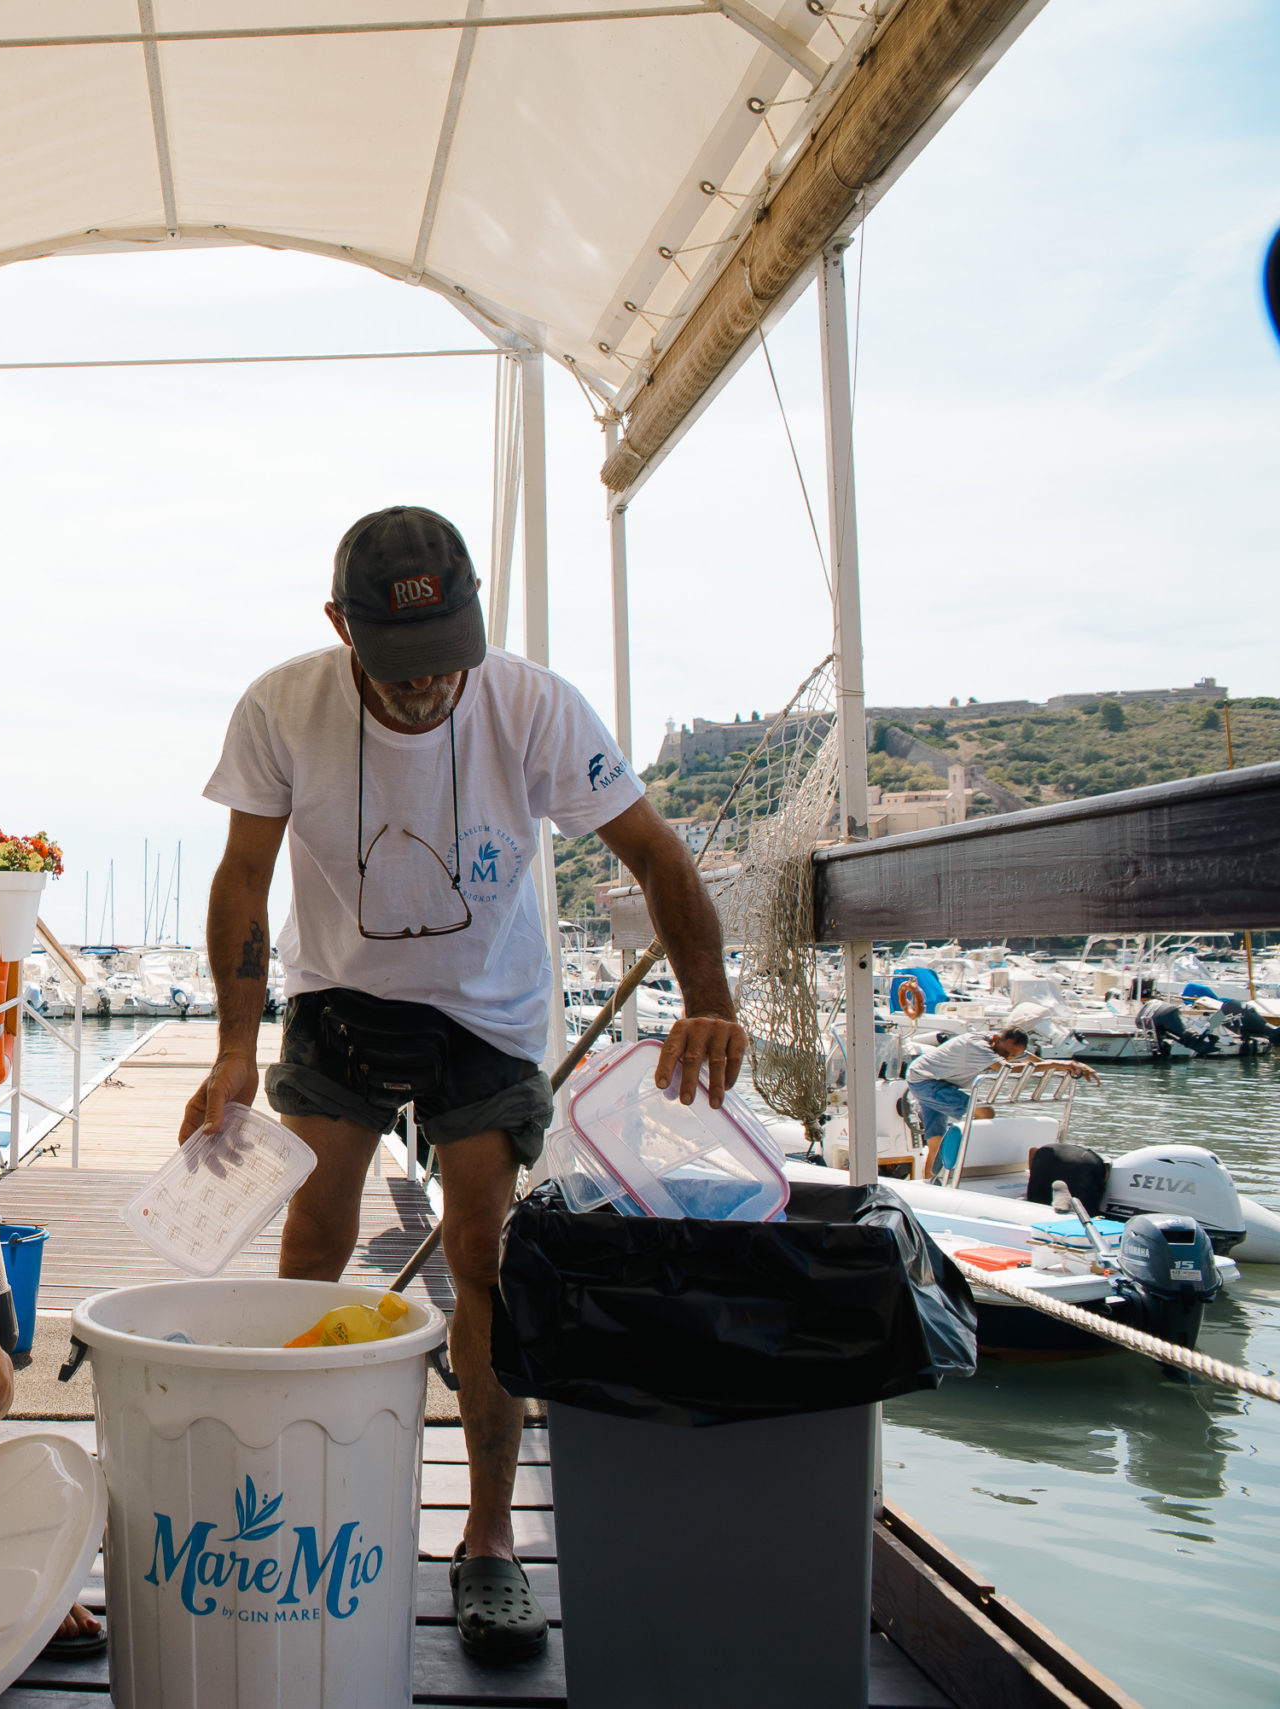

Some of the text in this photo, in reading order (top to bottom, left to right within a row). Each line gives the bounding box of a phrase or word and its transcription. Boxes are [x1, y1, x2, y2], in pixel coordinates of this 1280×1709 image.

[393, 577, 433, 604] RDS
[470, 860, 498, 882] M
[1129, 1173, 1196, 1195] SELVA
[1174, 1260, 1195, 1270] 15
[144, 1512, 383, 1619] Mare Mio
[222, 1606, 321, 1623] by GIN MARE
